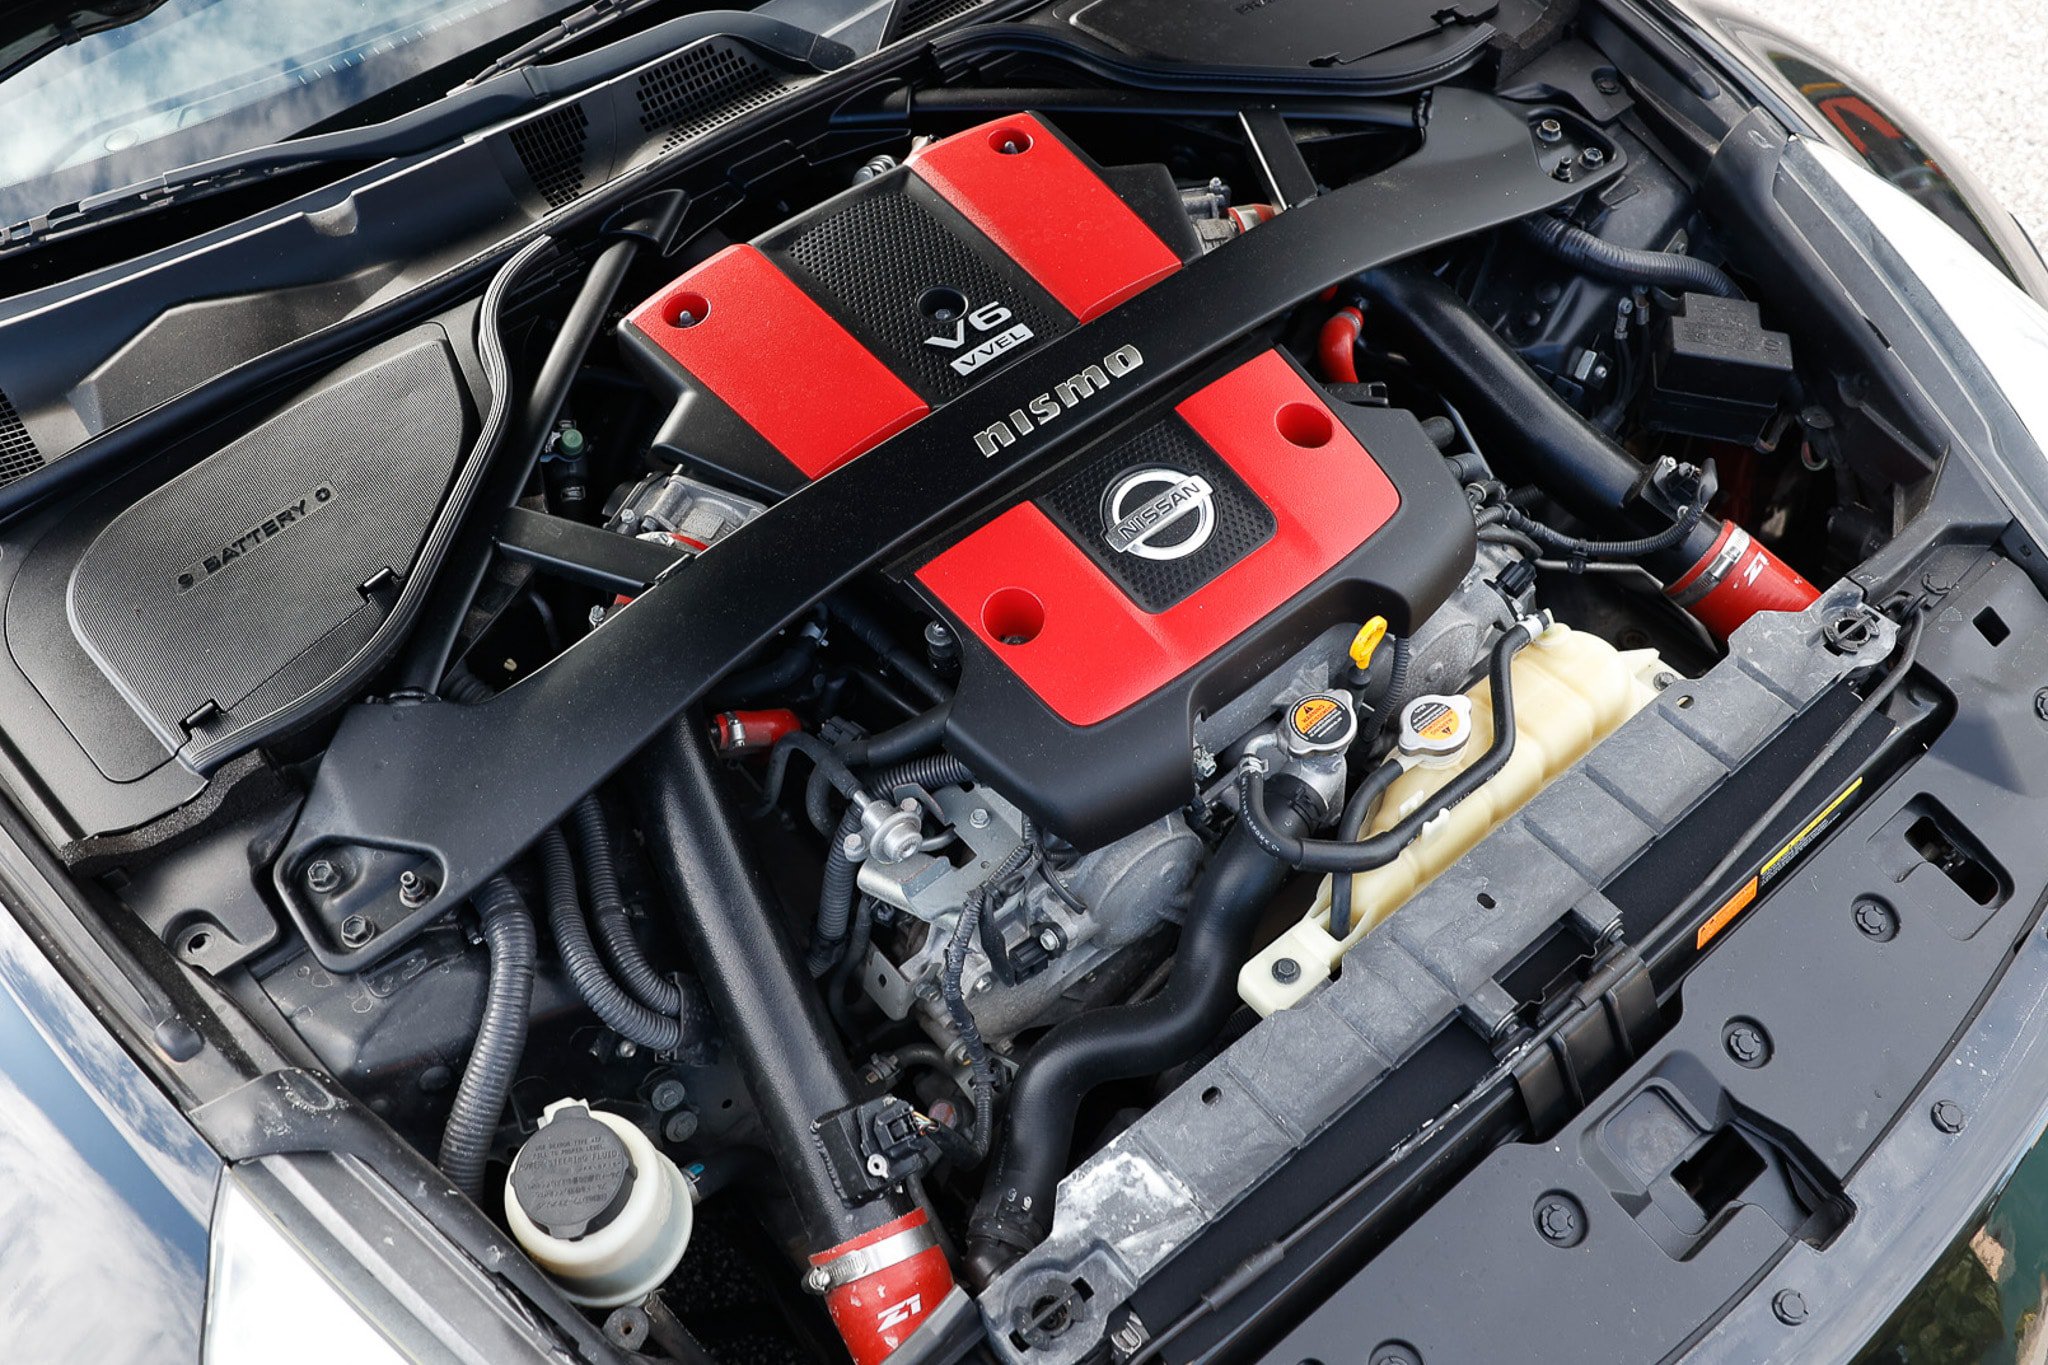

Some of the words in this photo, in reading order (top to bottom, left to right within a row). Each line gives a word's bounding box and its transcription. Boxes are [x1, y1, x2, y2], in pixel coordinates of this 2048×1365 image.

[923, 300, 1012, 349] V6
[960, 330, 1026, 367] VVEL
[973, 344, 1144, 458] nismo
[202, 499, 306, 574] BATTERY
[1118, 482, 1201, 541] NISSAN
[877, 1293, 921, 1333] Z1
